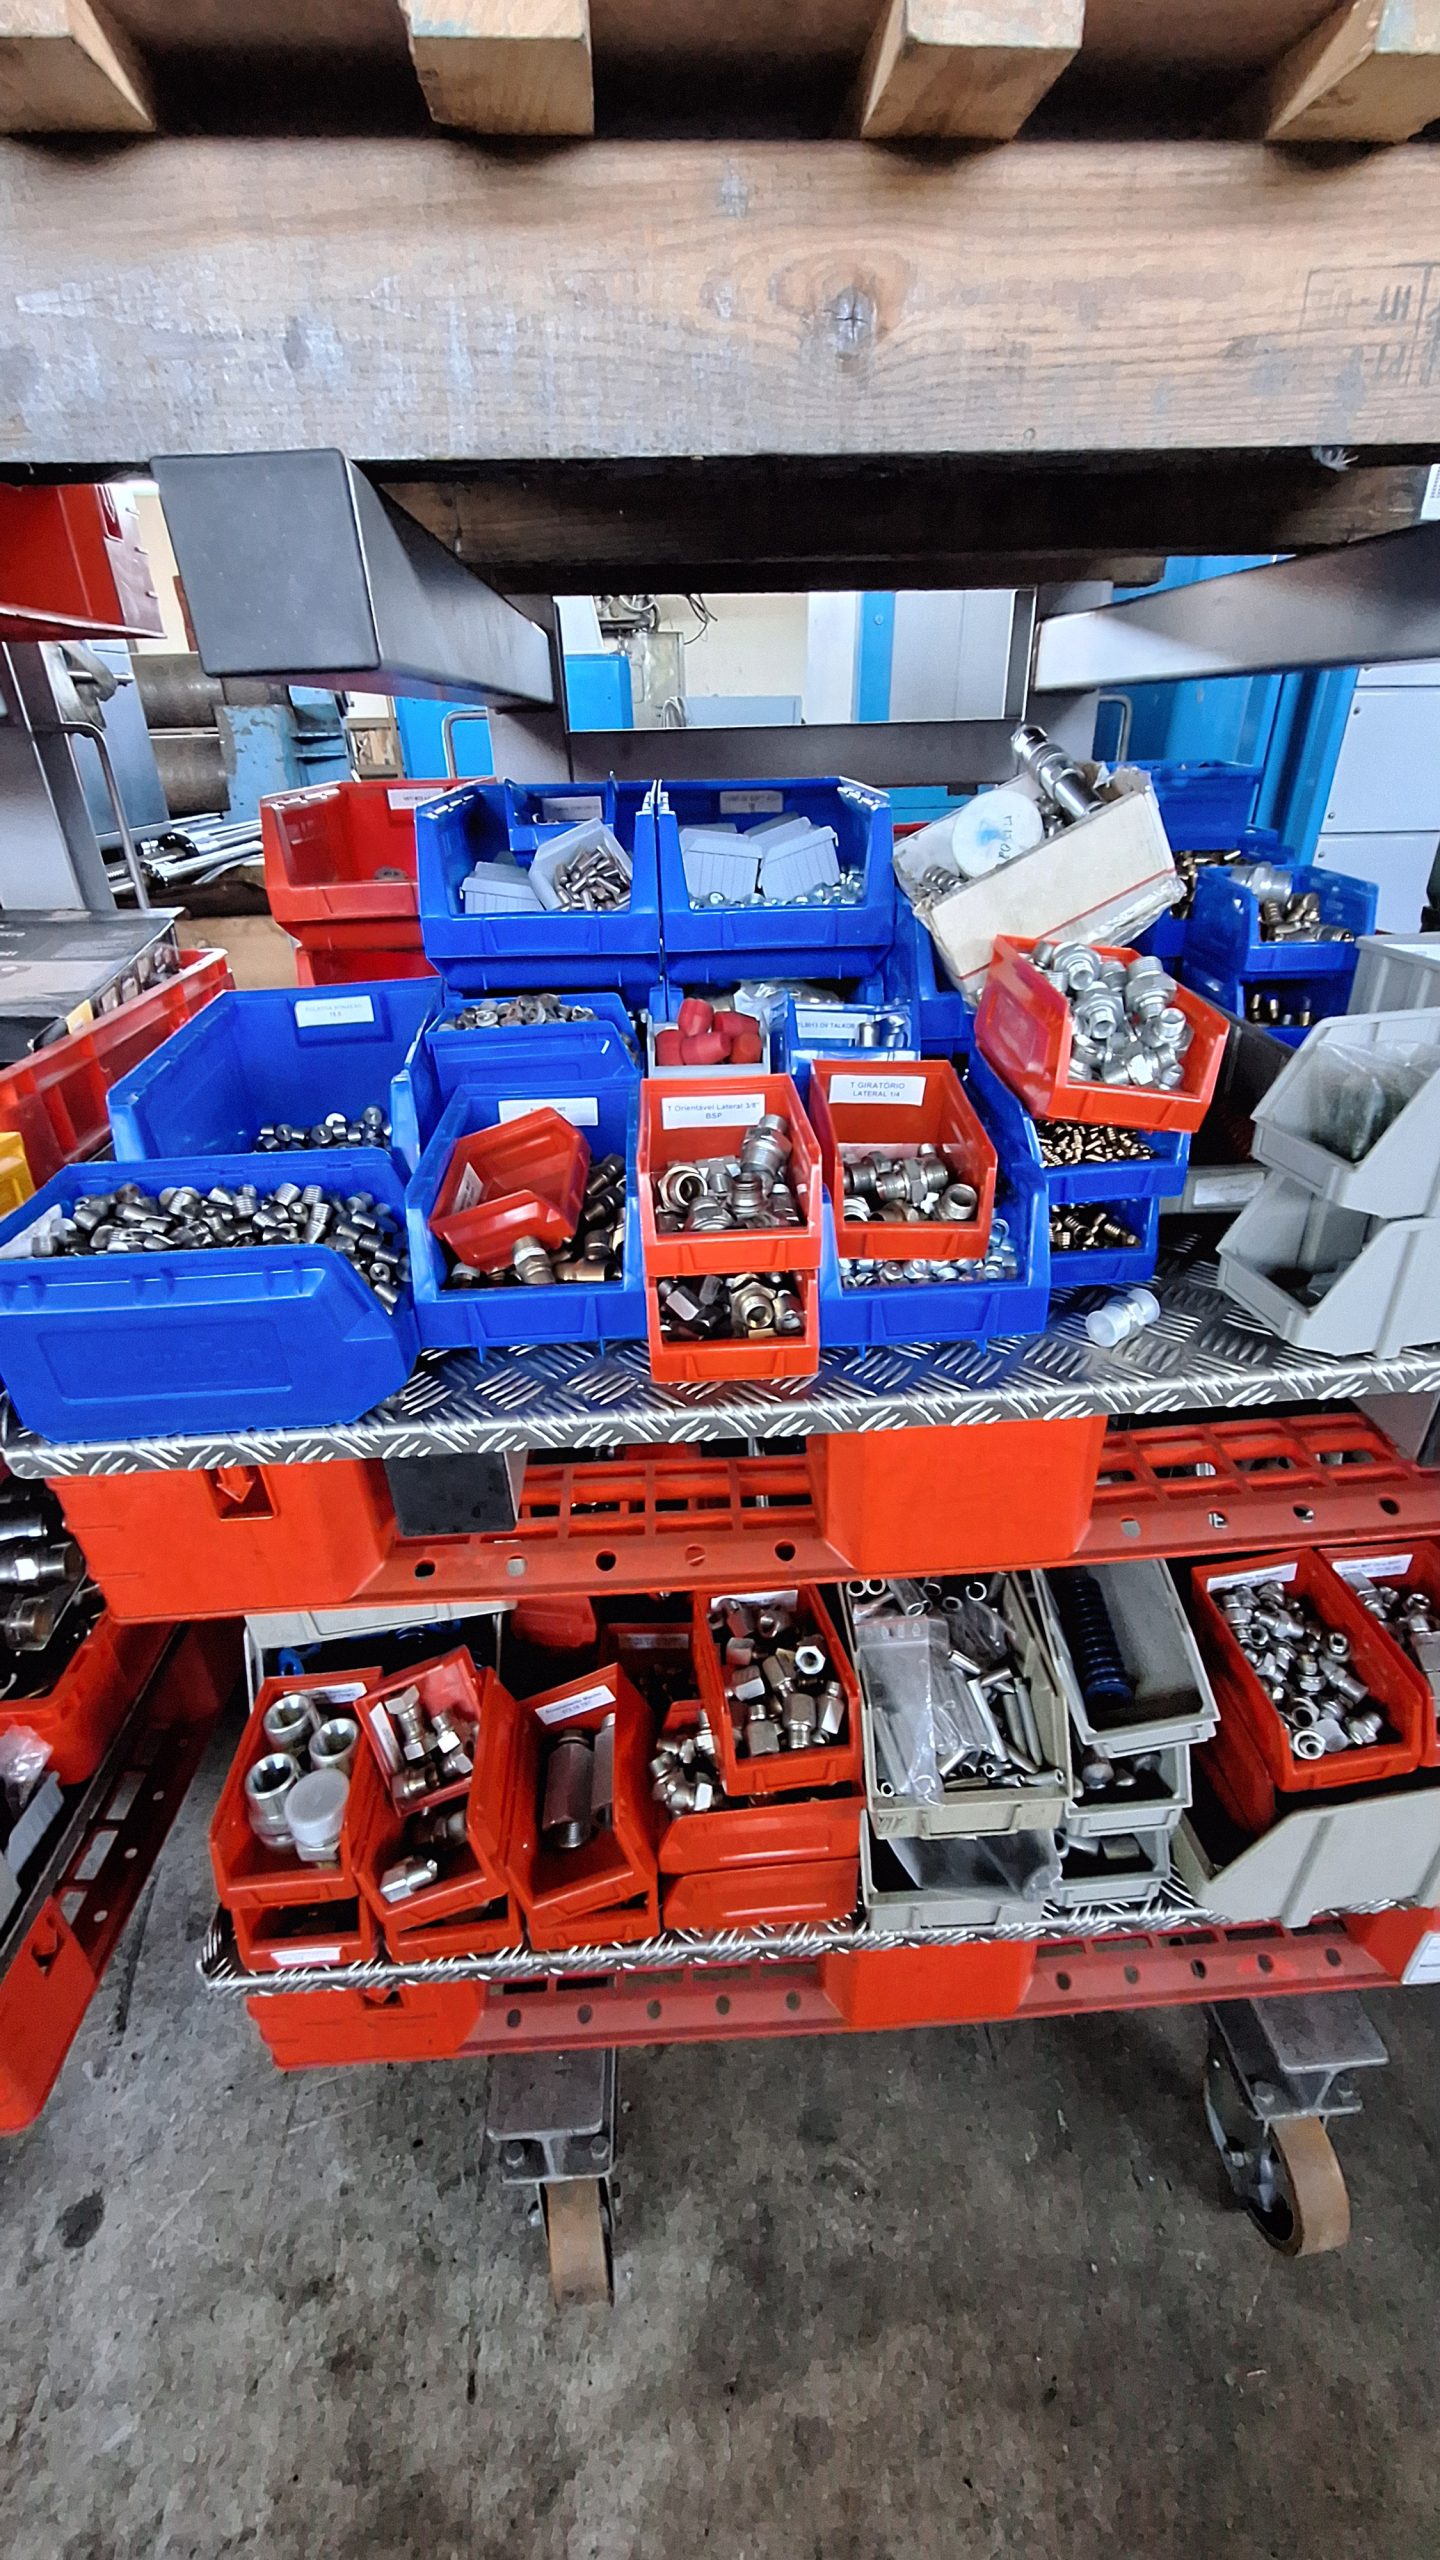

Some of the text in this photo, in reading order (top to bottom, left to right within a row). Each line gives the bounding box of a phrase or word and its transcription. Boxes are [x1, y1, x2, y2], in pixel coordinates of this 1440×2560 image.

[852, 1090, 887, 1098] LATERAL
[716, 1102, 744, 1111] Lateral
[705, 1112, 723, 1120] BSP
